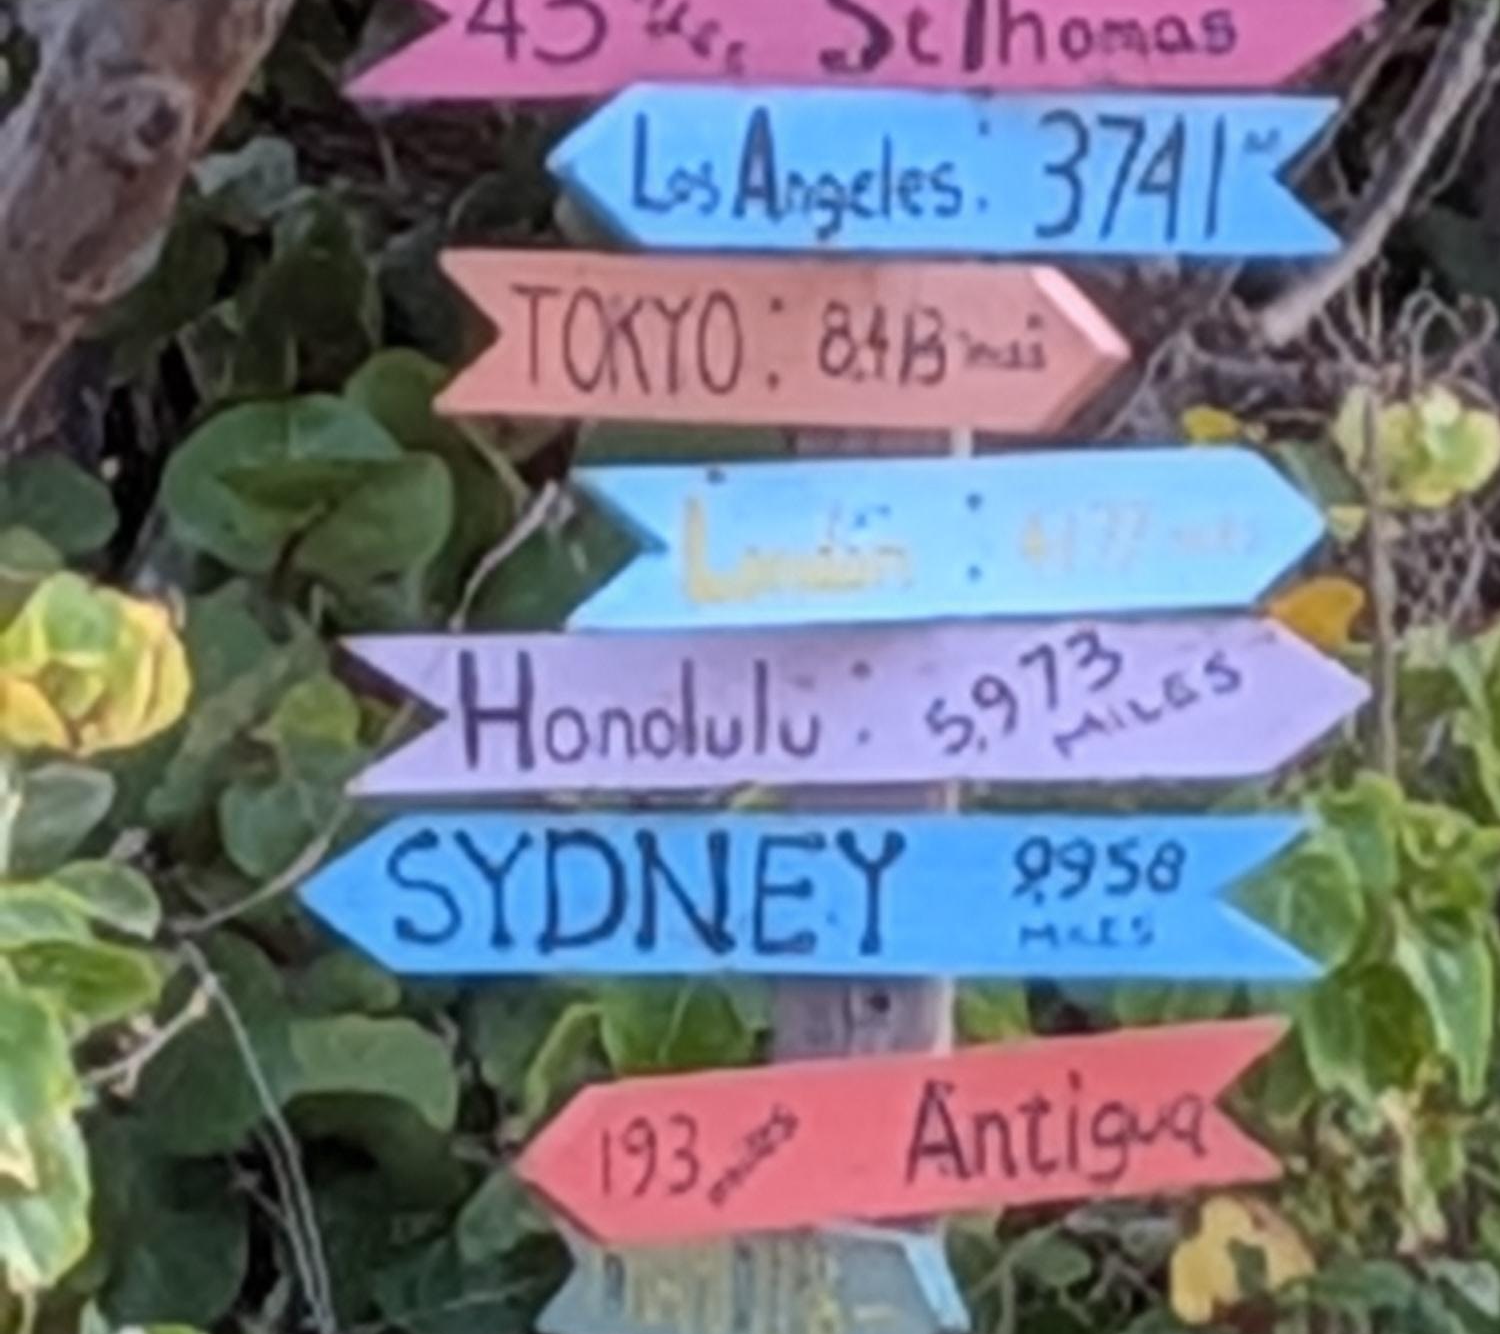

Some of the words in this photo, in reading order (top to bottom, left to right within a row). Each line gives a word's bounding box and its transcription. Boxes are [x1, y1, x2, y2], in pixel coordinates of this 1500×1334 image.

[631, 111, 721, 215] Los
[1034, 109, 1227, 243] 3741
[385, 827, 909, 959] SYDNEY
[601, 1110, 702, 1198] 193
[903, 1071, 1210, 1183] Antigua
